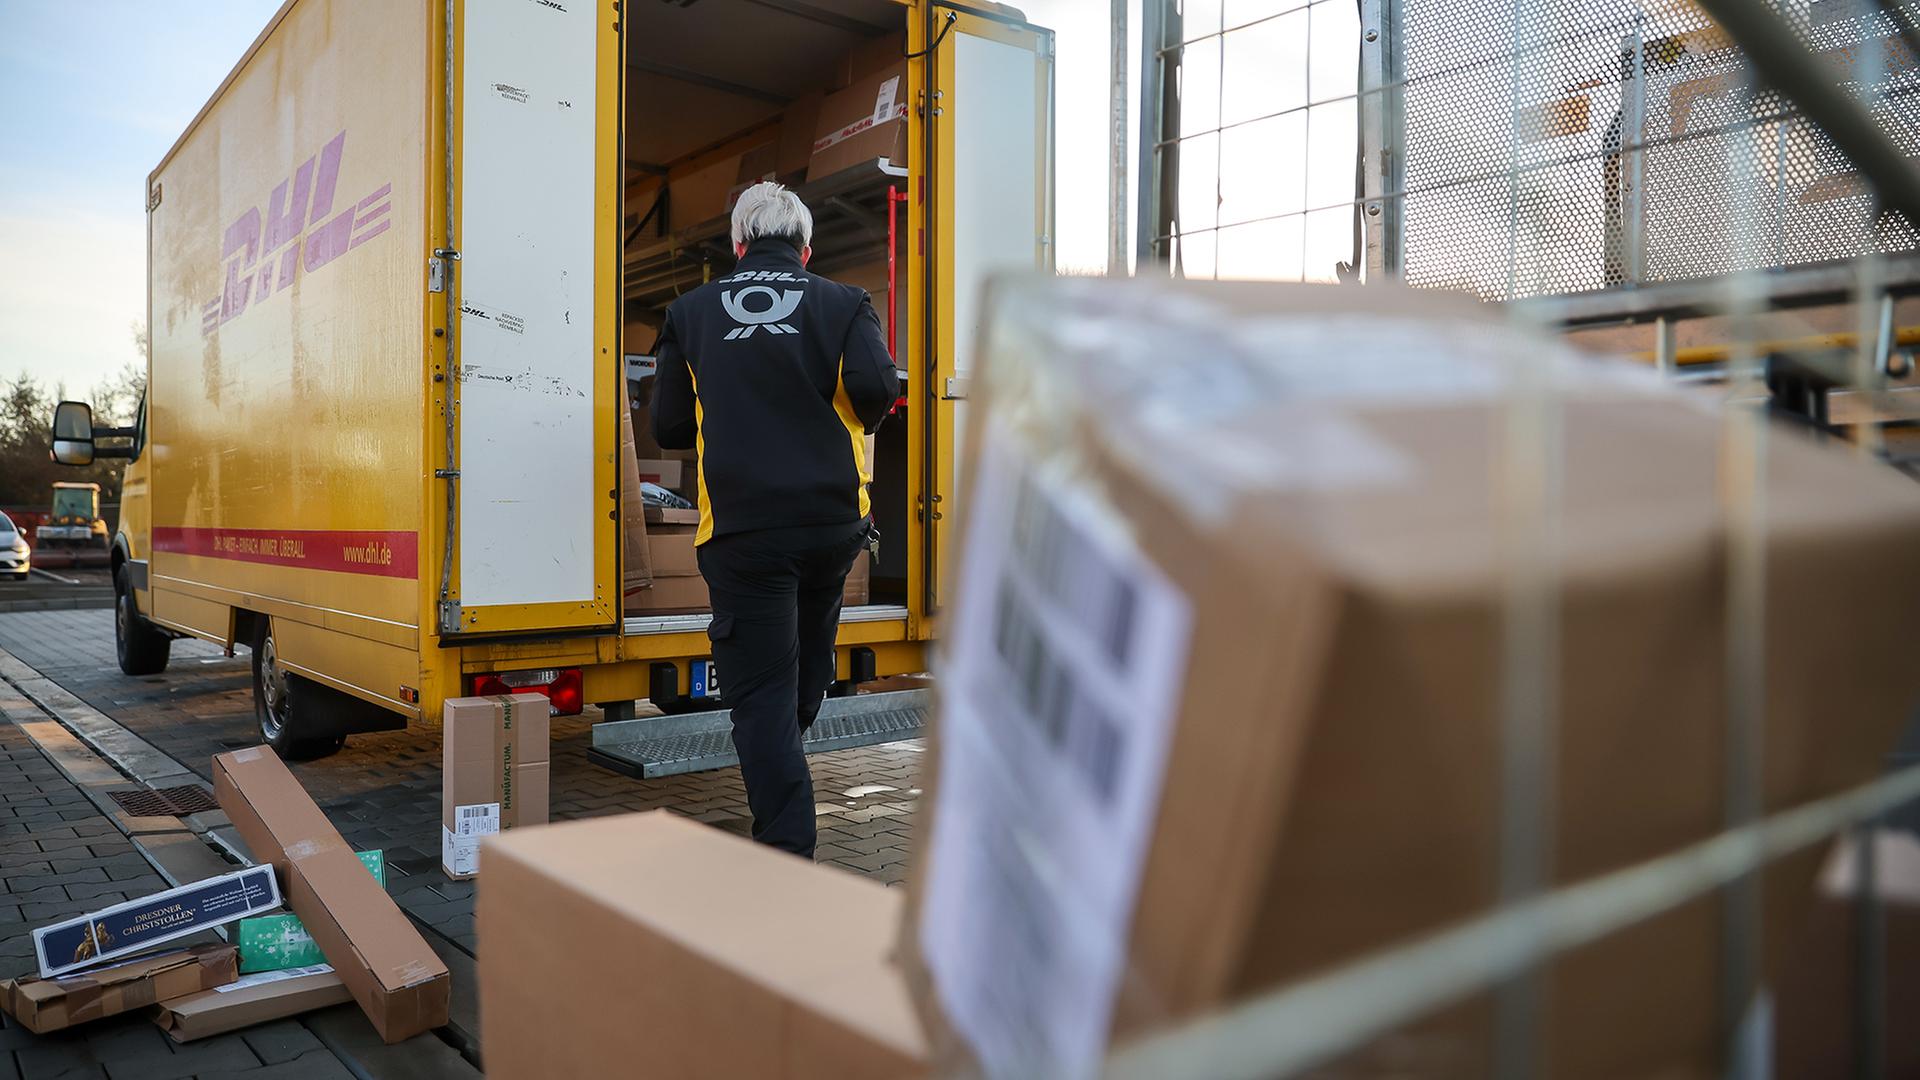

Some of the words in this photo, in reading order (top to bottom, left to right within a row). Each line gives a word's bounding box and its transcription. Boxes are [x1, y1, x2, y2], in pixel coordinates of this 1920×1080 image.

[214, 129, 362, 328] DHL
[726, 270, 800, 284] DHL
[343, 541, 391, 565] www.dhl.de
[708, 664, 720, 692] B
[135, 903, 182, 923] DRESDNER
